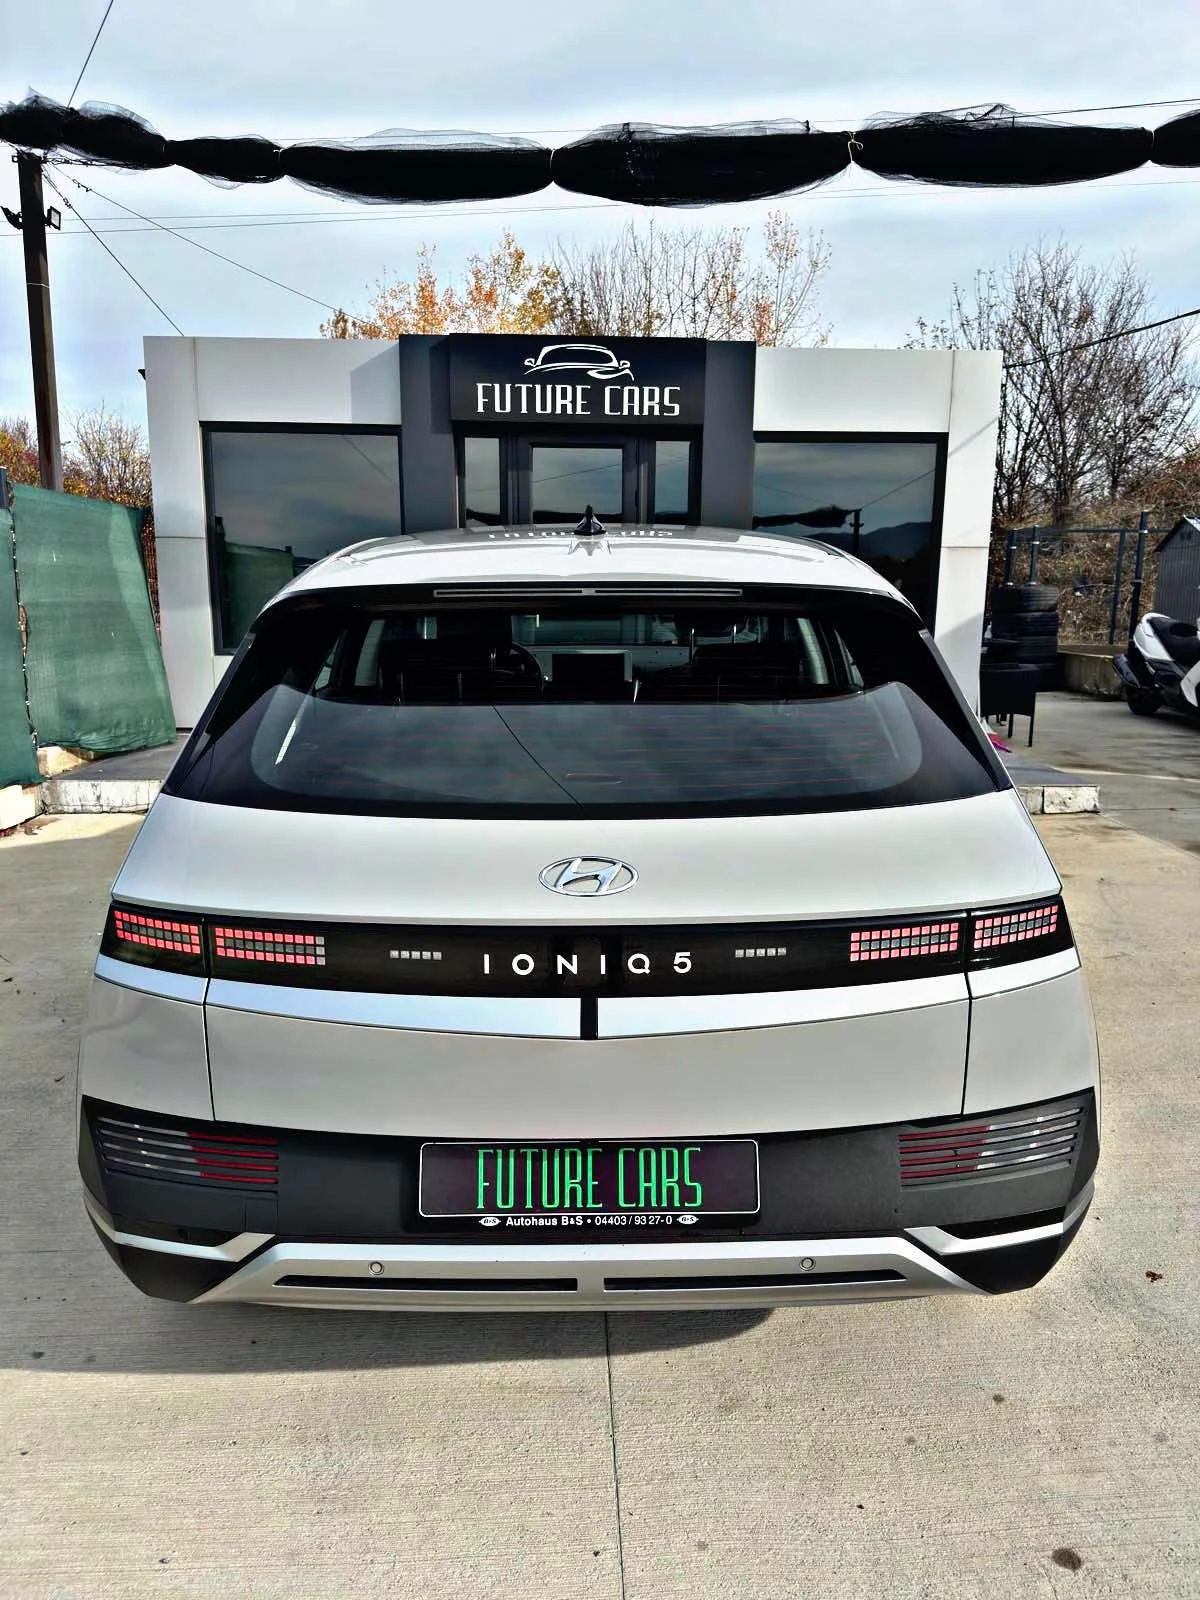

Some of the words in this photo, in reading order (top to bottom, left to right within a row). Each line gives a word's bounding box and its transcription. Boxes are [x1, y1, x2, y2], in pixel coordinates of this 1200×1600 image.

[476, 383, 591, 415] FUTURE
[604, 385, 681, 417] CARS
[483, 953, 651, 976] IONIQ
[673, 951, 692, 975] 5
[476, 1148, 602, 1209] FUTURE
[618, 1147, 702, 1208] CARS
[505, 1216, 558, 1227] Autohaus
[561, 1215, 584, 1226] B&S
